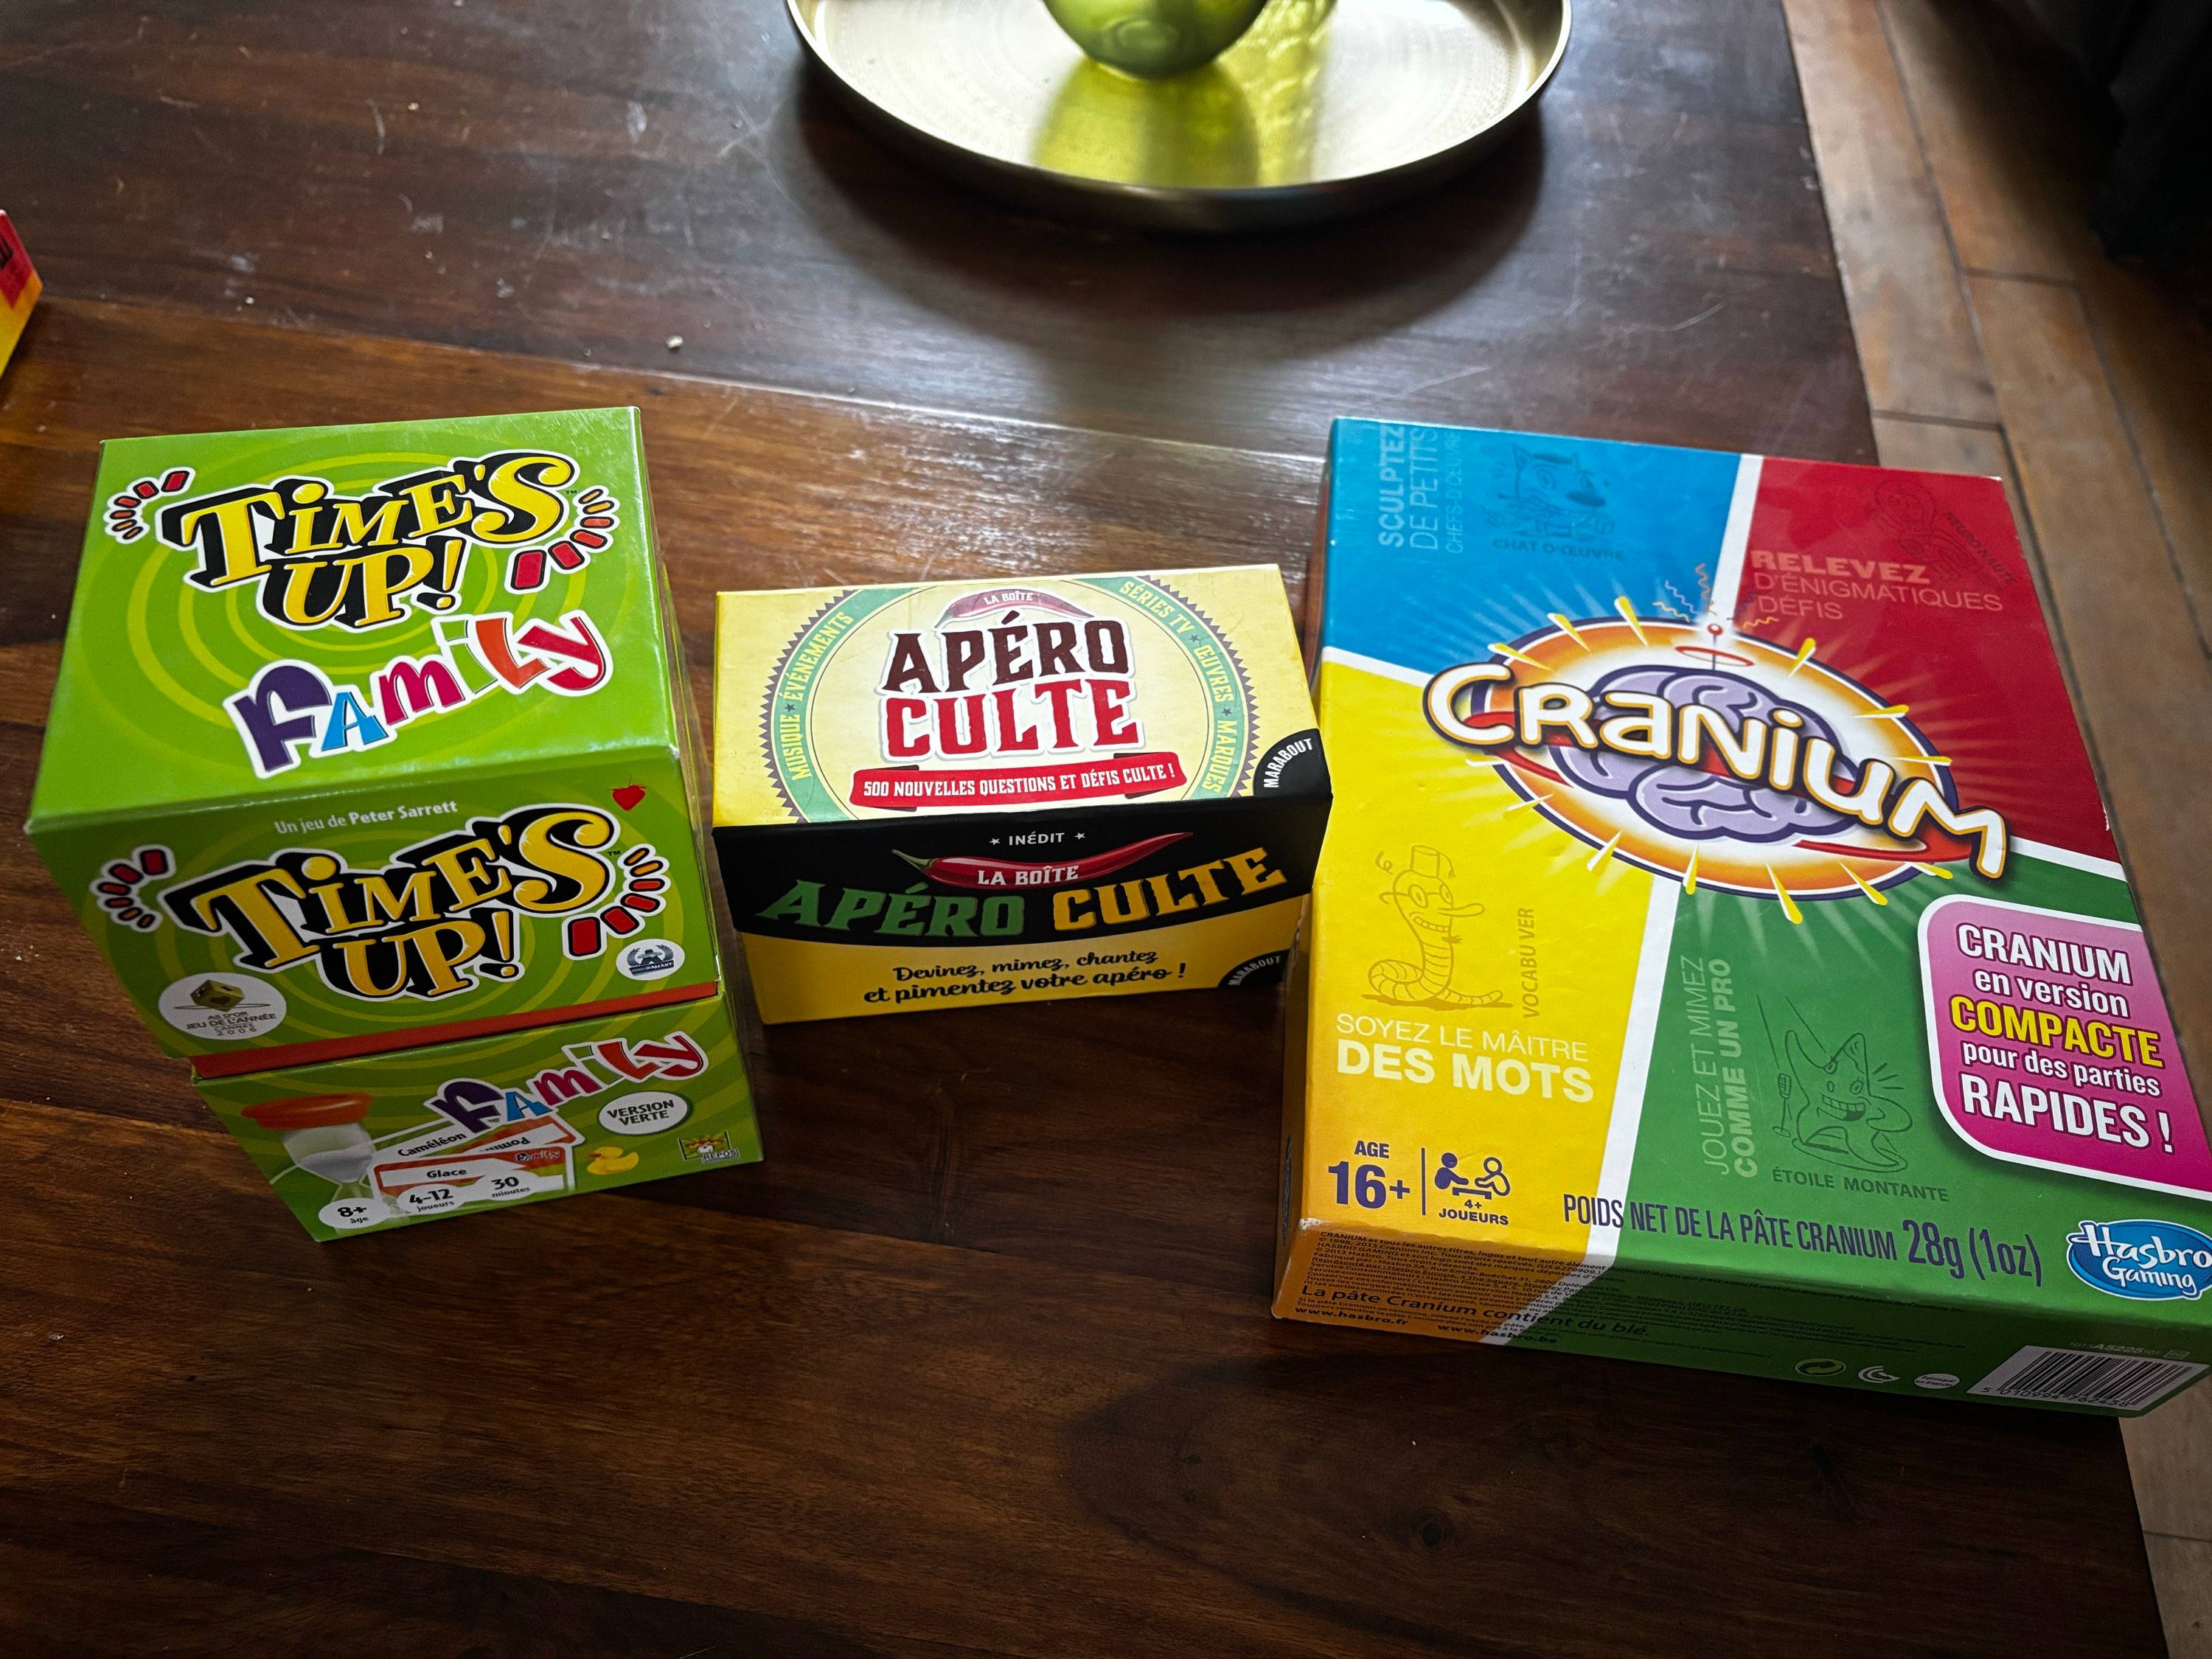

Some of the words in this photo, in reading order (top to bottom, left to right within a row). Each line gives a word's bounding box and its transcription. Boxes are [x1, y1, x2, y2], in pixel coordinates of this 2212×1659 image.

[1378, 424, 1405, 548] SCULPTEZ
[1410, 428, 1438, 508] PETITS
[1410, 515, 1438, 550] DE
[1493, 539, 1537, 552] CHAT
[262, 536, 465, 627] UP!
[1750, 549, 1930, 585] RELEVEZ
[984, 593, 1003, 605] LA
[1004, 590, 1034, 602] BOÎTE
[1119, 580, 1175, 619] SÉRIES
[1169, 616, 1196, 634] TV
[1753, 571, 2003, 612] D'ÉNIGMATIQUES
[1758, 592, 1843, 620] DÉFIS
[779, 611, 855, 702] ÉVÉNEMENTS
[882, 610, 1129, 694] APÉRO
[1193, 644, 1235, 703] ŒUVRES
[886, 678, 1139, 757] CULTE
[779, 714, 813, 782] MUSIQUE
[1203, 720, 1238, 793] MARQUES
[1263, 738, 1313, 788] MARABOUT
[863, 780, 889, 797] 500
[893, 779, 975, 797] NOUVELLES
[978, 775, 1057, 796] QUESTIONS
[1060, 773, 1078, 790] ET
[1082, 768, 1120, 788] DÉFIS
[1123, 764, 1165, 784] CULTE
[1168, 762, 1176, 778] !
[274, 821, 299, 834] Un
[301, 818, 324, 834] jeu
[327, 814, 347, 827] de
[348, 810, 395, 825] Peter
[397, 801, 458, 819] Sarrett
[1009, 831, 1065, 846] INÉDIT
[756, 880, 1026, 937] APÉRO
[1053, 847, 1287, 932] CULTE
[978, 869, 1007, 886] LA
[1015, 865, 1079, 886] BOÎTE
[1517, 906, 1535, 943] VER
[320, 910, 521, 998] UP!
[893, 964, 986, 981] Devinez,
[992, 957, 1070, 974] mimez,
[1076, 950, 1159, 967] chantez
[1227, 955, 1281, 986] MARABOUT
[1958, 923, 2132, 985] CRANIUM
[863, 988, 891, 1004] et
[894, 978, 1017, 1004] pimentez
[1020, 970, 1088, 990] votre
[1092, 966, 1172, 987] apéro
[1517, 945, 1541, 1020] VOCABU
[1680, 955, 1713, 1037] MIMEZ
[1707, 959, 1736, 1012] PRO
[1975, 970, 2011, 995] en
[2017, 977, 2129, 1018] version
[185, 1022, 207, 1030] JEU
[227, 1013, 277, 1024] L'ANNÉE
[214, 1023, 255, 1032] CANNES
[216, 1027, 257, 1036] 2006
[1337, 1012, 1431, 1044] SOYEZ
[1439, 1025, 1474, 1048] LE
[1716, 1020, 1742, 1058] UN
[1950, 995, 2163, 1068] COMPACTE
[1337, 1037, 1435, 1085] DES
[1451, 1052, 1594, 1103] MOTS
[1690, 1043, 1718, 1077] ET
[1962, 1041, 2018, 1069] pour
[2024, 1050, 2067, 1079] des
[2073, 1063, 2161, 1096] parties
[606, 1099, 675, 1119] VERSION
[618, 1110, 669, 1126] VERTE
[1722, 1066, 1759, 1178] COMME
[1961, 1073, 2150, 1149] RAPIDES
[2158, 1111, 2174, 1153] !
[397, 1132, 467, 1157] Caméléon
[1696, 1082, 1730, 1176] JOUEZ
[703, 1149, 737, 1161] REPOS
[1354, 1140, 1390, 1159] AGE
[426, 1167, 467, 1178] Glace
[490, 1176, 520, 1190] 30
[1328, 1161, 1411, 1209] 16+
[1771, 1166, 1835, 1189] ÉTOILE
[1843, 1176, 1950, 1203] MONTANTE
[409, 1188, 453, 1205] 4-12
[417, 1200, 455, 1212] joueurs
[491, 1185, 531, 1198] minutes
[1464, 1199, 1483, 1209] 4+
[337, 1206, 367, 1217] 8+
[1439, 1208, 1509, 1226] JOUEURS
[1317, 1242, 1356, 1251] HASBRO
[1358, 1247, 1398, 1256] GAMING
[1320, 1231, 1366, 1242] CRANIUM
[1478, 1251, 1503, 1259] logos
[1566, 1261, 1604, 1270] élément
[1379, 1245, 1419, 1253] Cranium
[1563, 1193, 1624, 1228] POIDS
[1630, 1201, 1669, 1234] NET
[1674, 1206, 1703, 1238] DE
[1706, 1209, 1736, 1242] LA
[1739, 1208, 1794, 1249] PÂTE
[1796, 1220, 1898, 1261] CRANIUM
[1902, 1219, 1965, 1280] 28g
[1969, 1227, 2042, 1288] (1oz)
[2070, 1224, 2212, 1269] Hasbro
[2101, 1256, 2198, 1296] Gaming
[1295, 1308, 1408, 1325] www.hasbro.fr
[1301, 1285, 1326, 1297] La
[1332, 1288, 1380, 1306] pâte
[1386, 1296, 1476, 1315] Cranium
[1482, 1308, 1573, 1326] contient
[1576, 1318, 1607, 1331] du
[1437, 1326, 1557, 1343] www.hasbro.be
[1999, 1388, 2062, 1399] 010994
